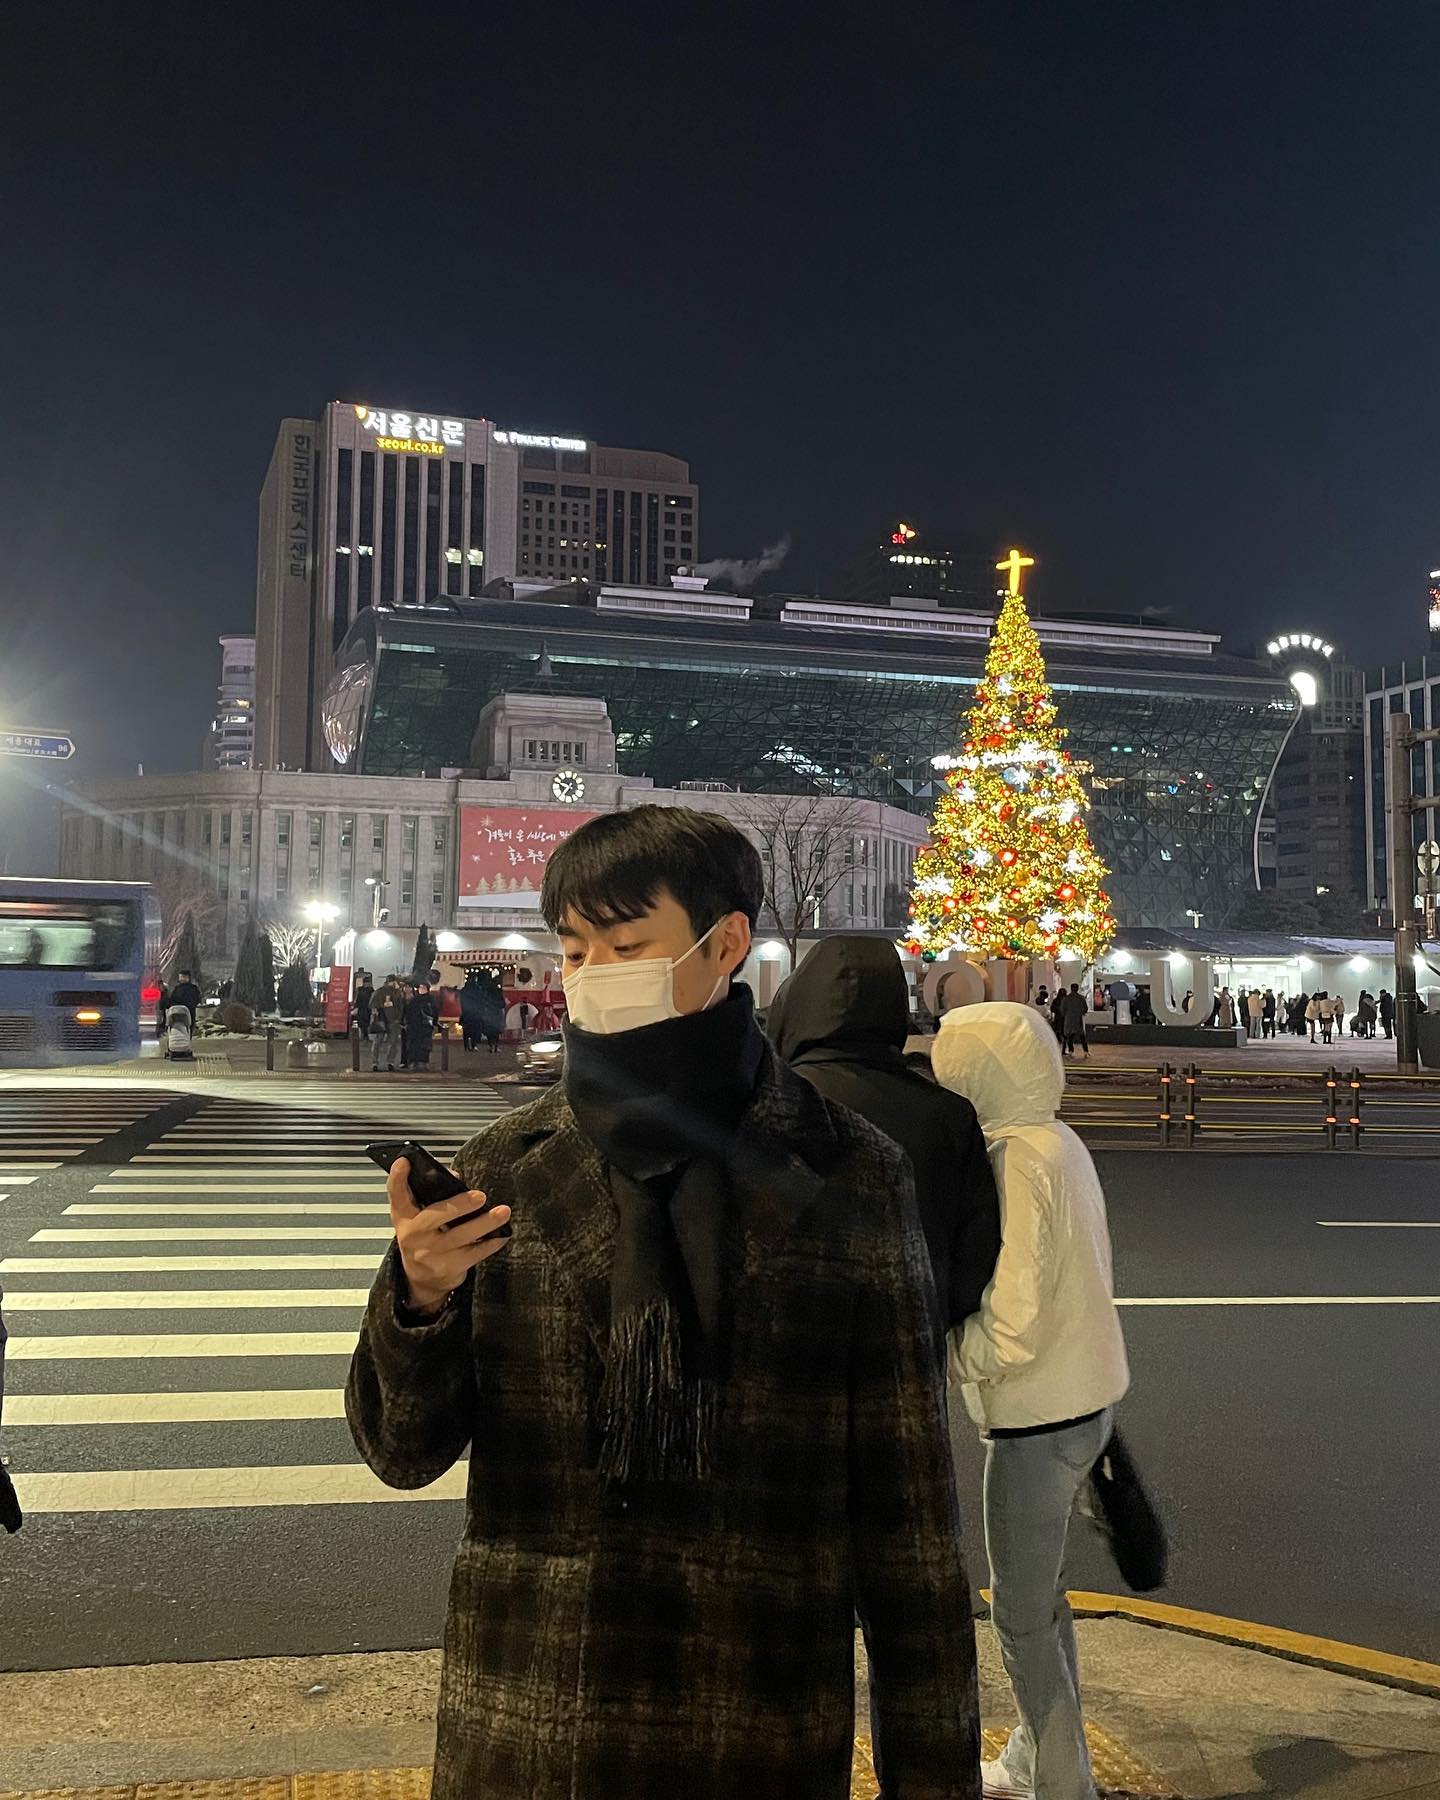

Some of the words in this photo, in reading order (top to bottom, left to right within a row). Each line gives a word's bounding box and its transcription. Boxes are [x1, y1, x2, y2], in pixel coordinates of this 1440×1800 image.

[364, 411, 465, 445] 서울신문
[376, 436, 445, 455] seoul.co.kr
[892, 533, 906, 544] SK
